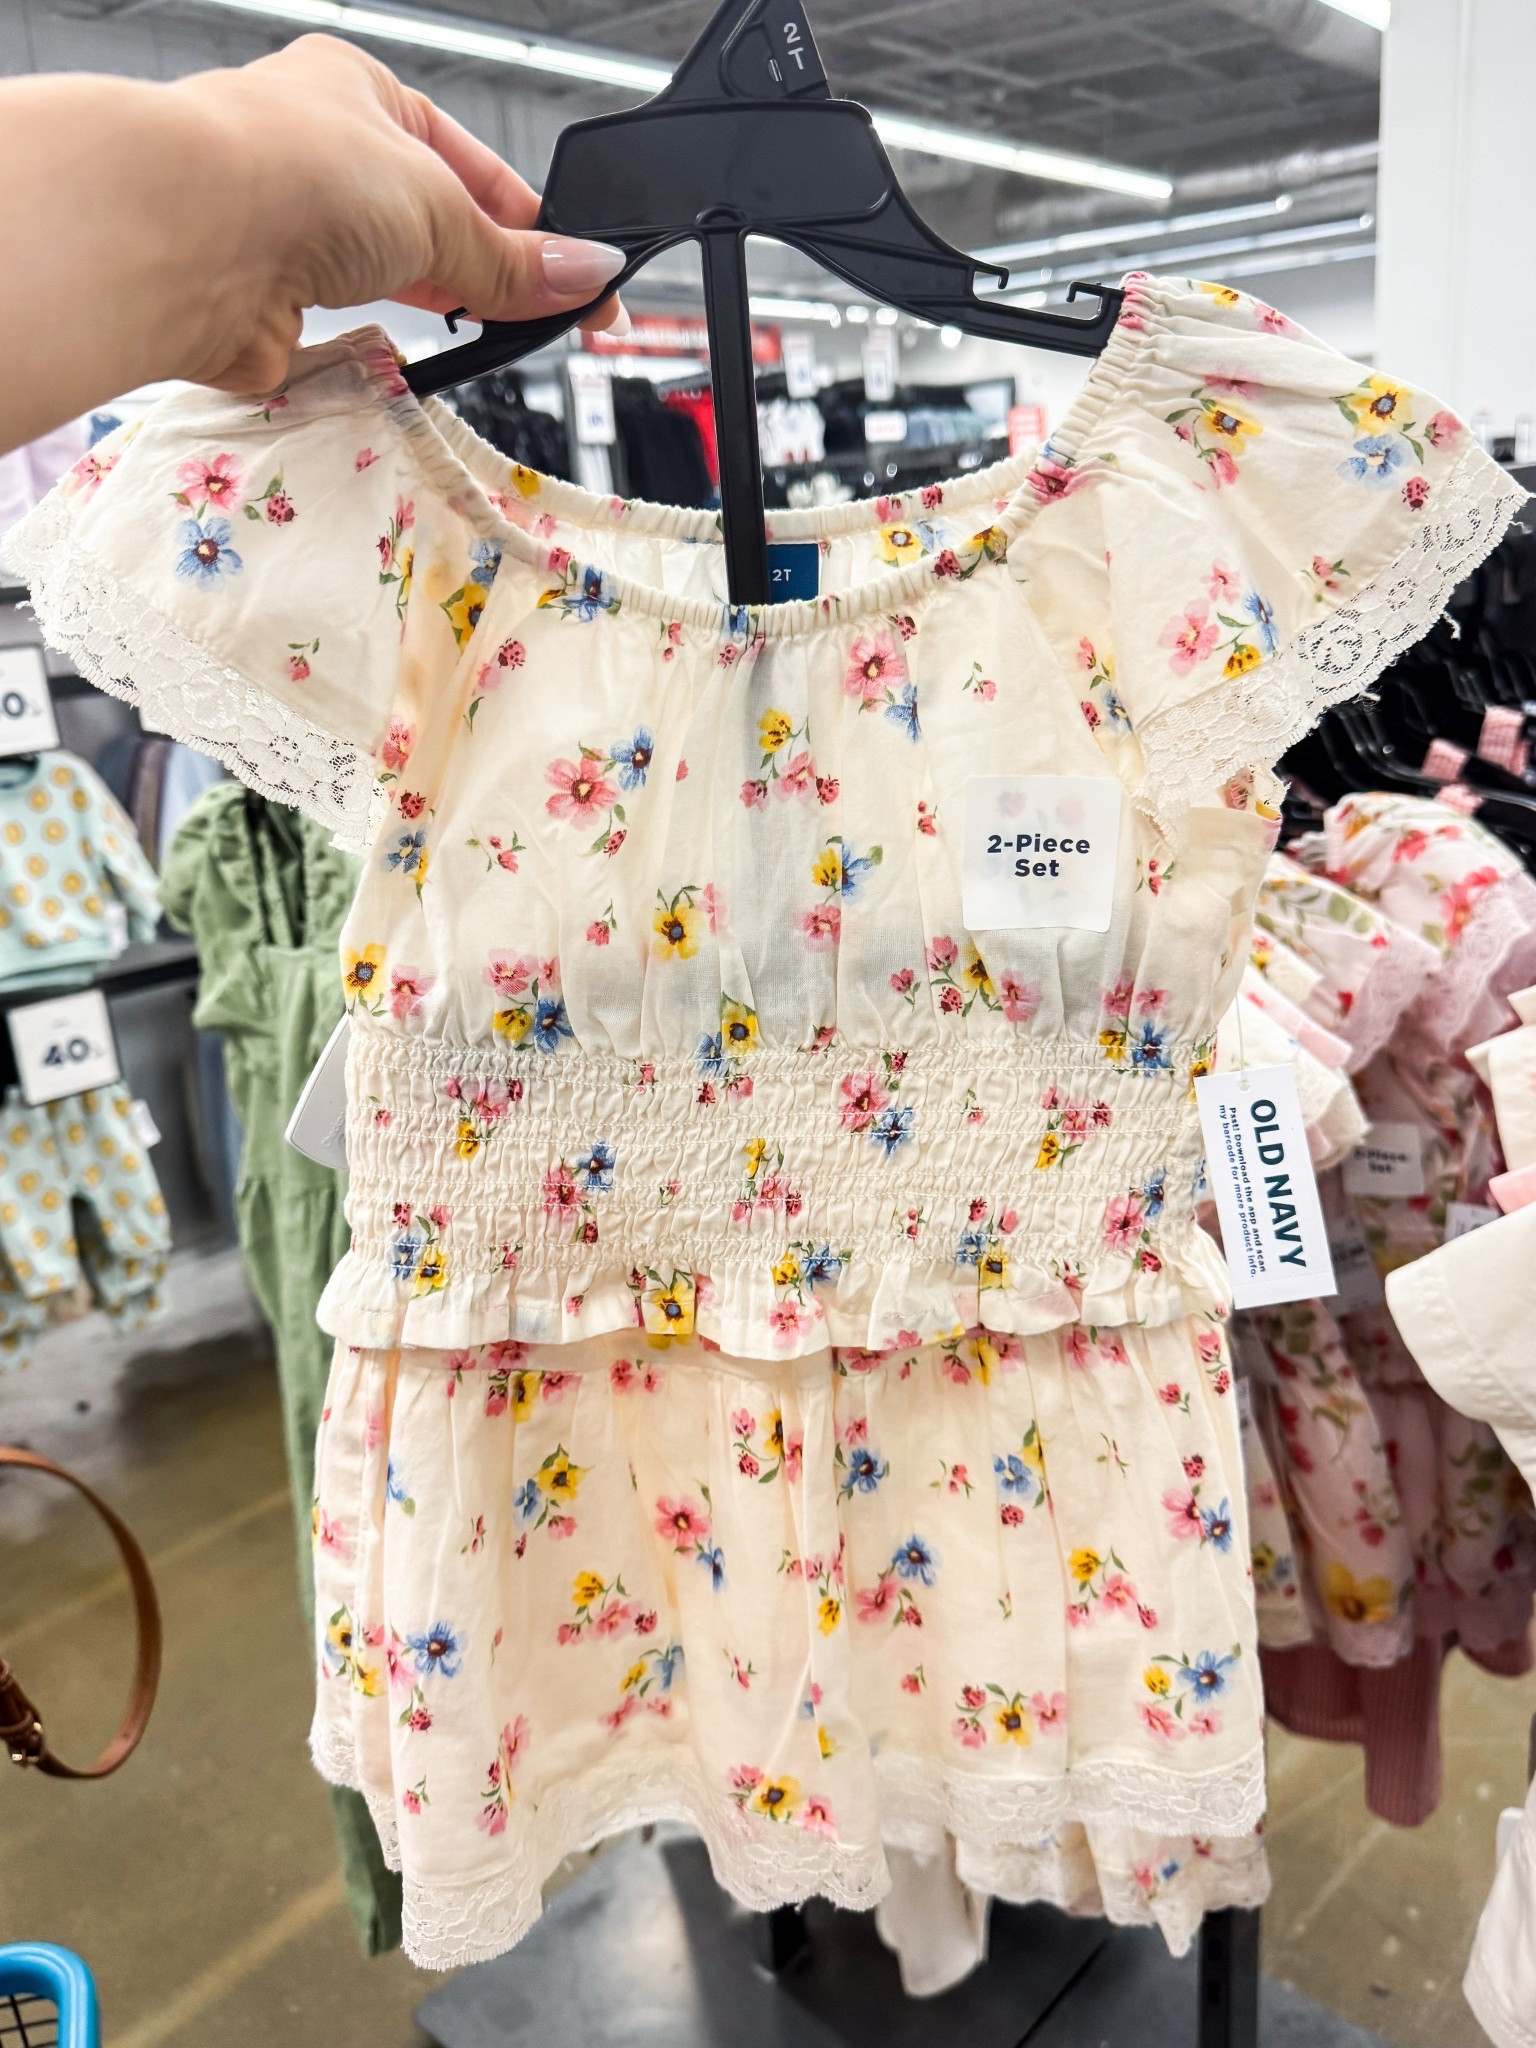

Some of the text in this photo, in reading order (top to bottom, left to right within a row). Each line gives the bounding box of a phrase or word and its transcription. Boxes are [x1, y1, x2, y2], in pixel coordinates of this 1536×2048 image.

[772, 568, 792, 582] 2T
[987, 833, 1091, 854] 2-Piece
[1014, 859, 1060, 877] Set
[43, 1038, 90, 1066] 40
[1219, 1105, 1258, 1278] my barcode for more product info.
[1229, 1107, 1266, 1272] Psst! Download the app and scan
[1250, 1099, 1307, 1268] OLD NAVY
